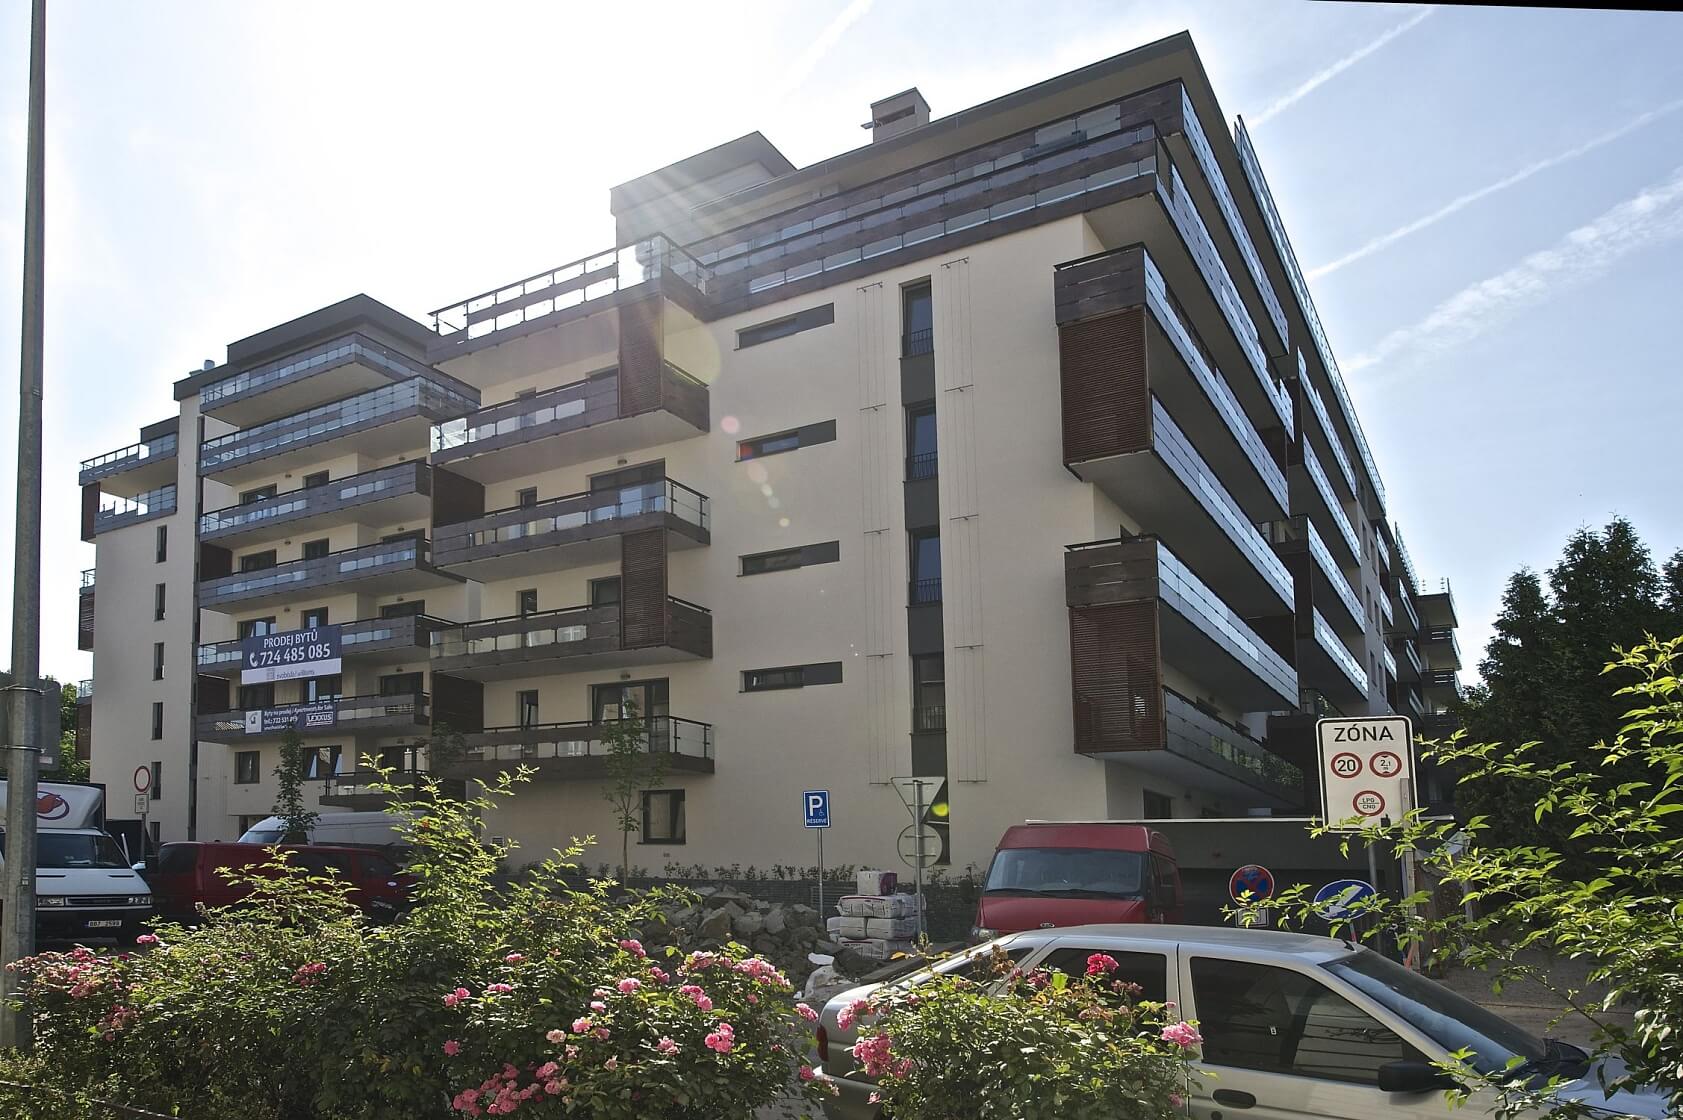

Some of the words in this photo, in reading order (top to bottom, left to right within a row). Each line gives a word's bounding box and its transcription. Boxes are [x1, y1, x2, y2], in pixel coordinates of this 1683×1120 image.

[264, 636, 294, 648] PRODEJ
[296, 629, 318, 644] BYTŮ
[260, 650, 281, 665] 724
[283, 647, 305, 663] 485
[308, 643, 331, 659] 085
[1334, 723, 1394, 742] ZÓNA
[1337, 759, 1356, 772] 20
[808, 795, 823, 816] P
